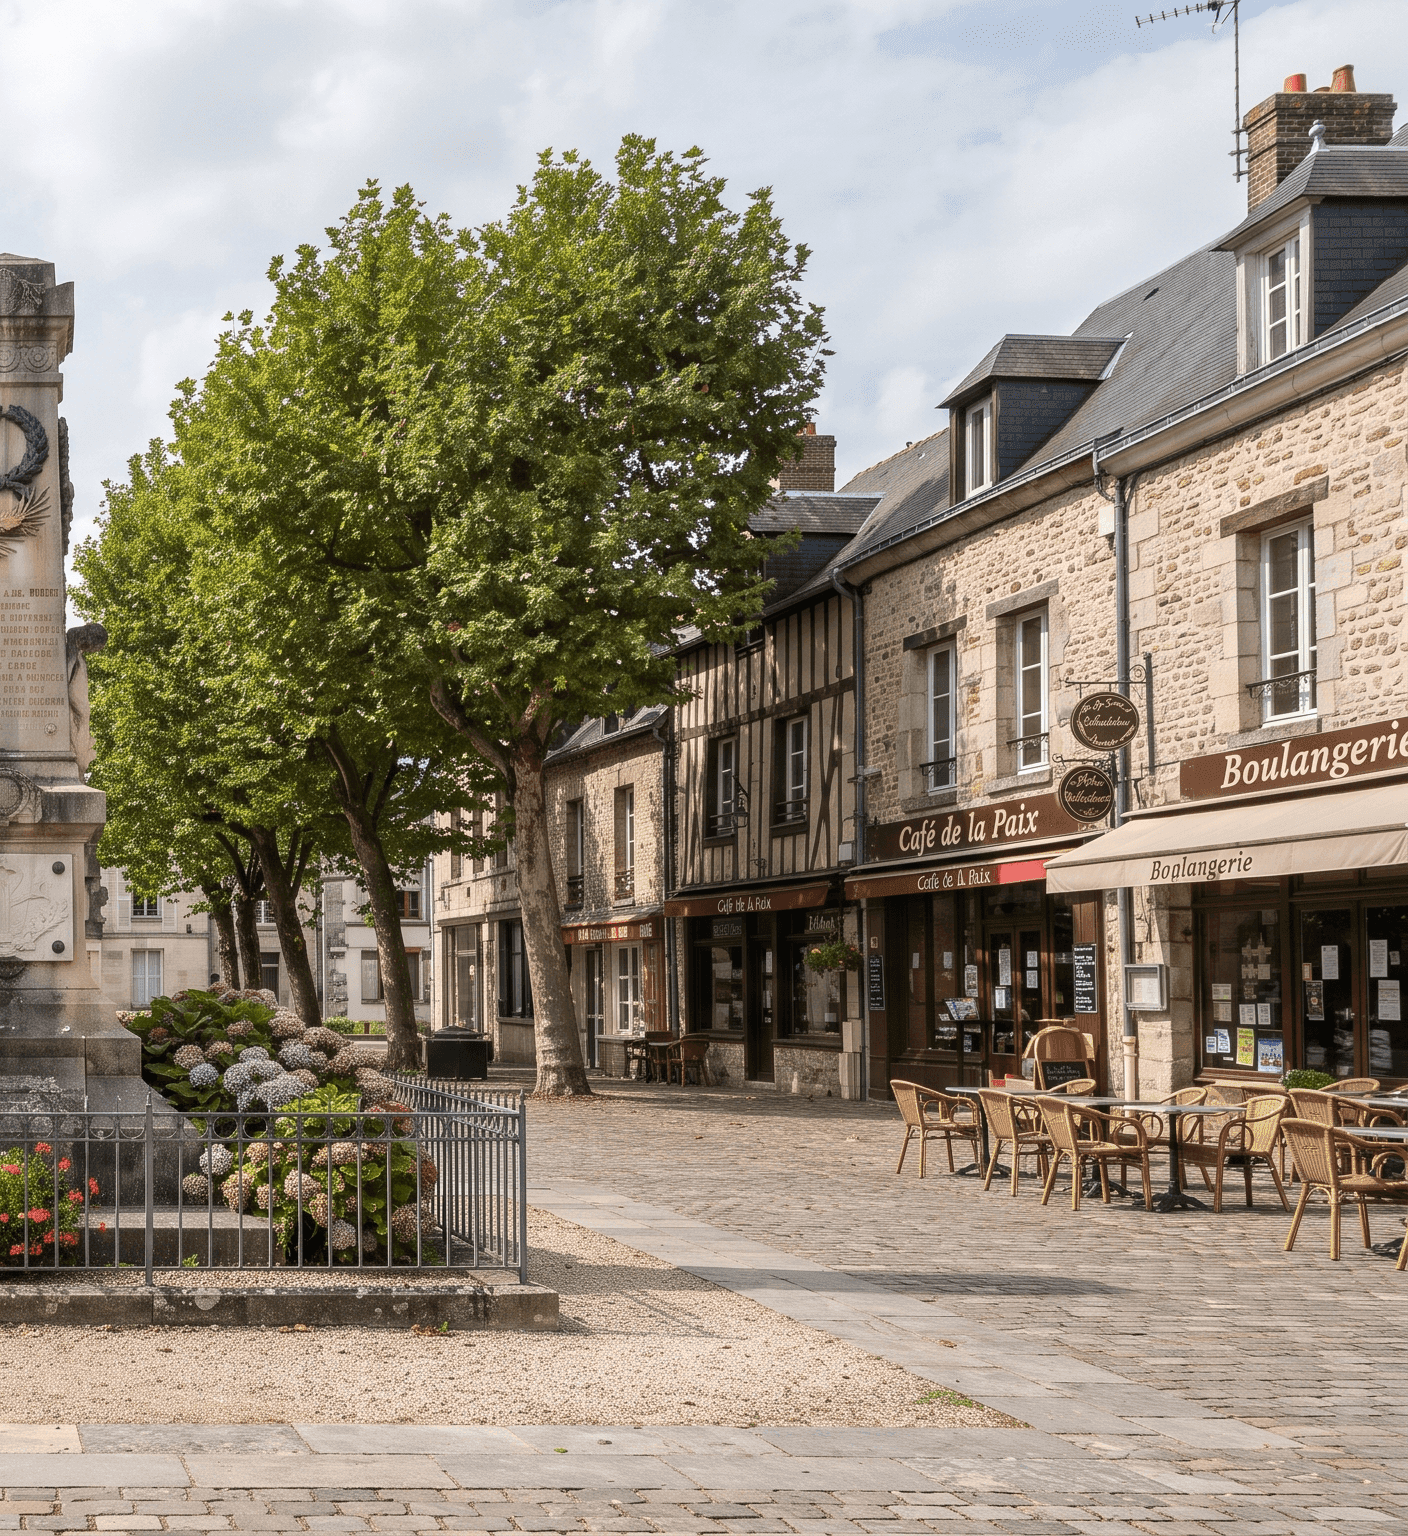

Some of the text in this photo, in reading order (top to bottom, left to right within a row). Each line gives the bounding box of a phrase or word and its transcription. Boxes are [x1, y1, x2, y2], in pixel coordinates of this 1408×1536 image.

[899, 803, 1039, 857] Café de la Paix
